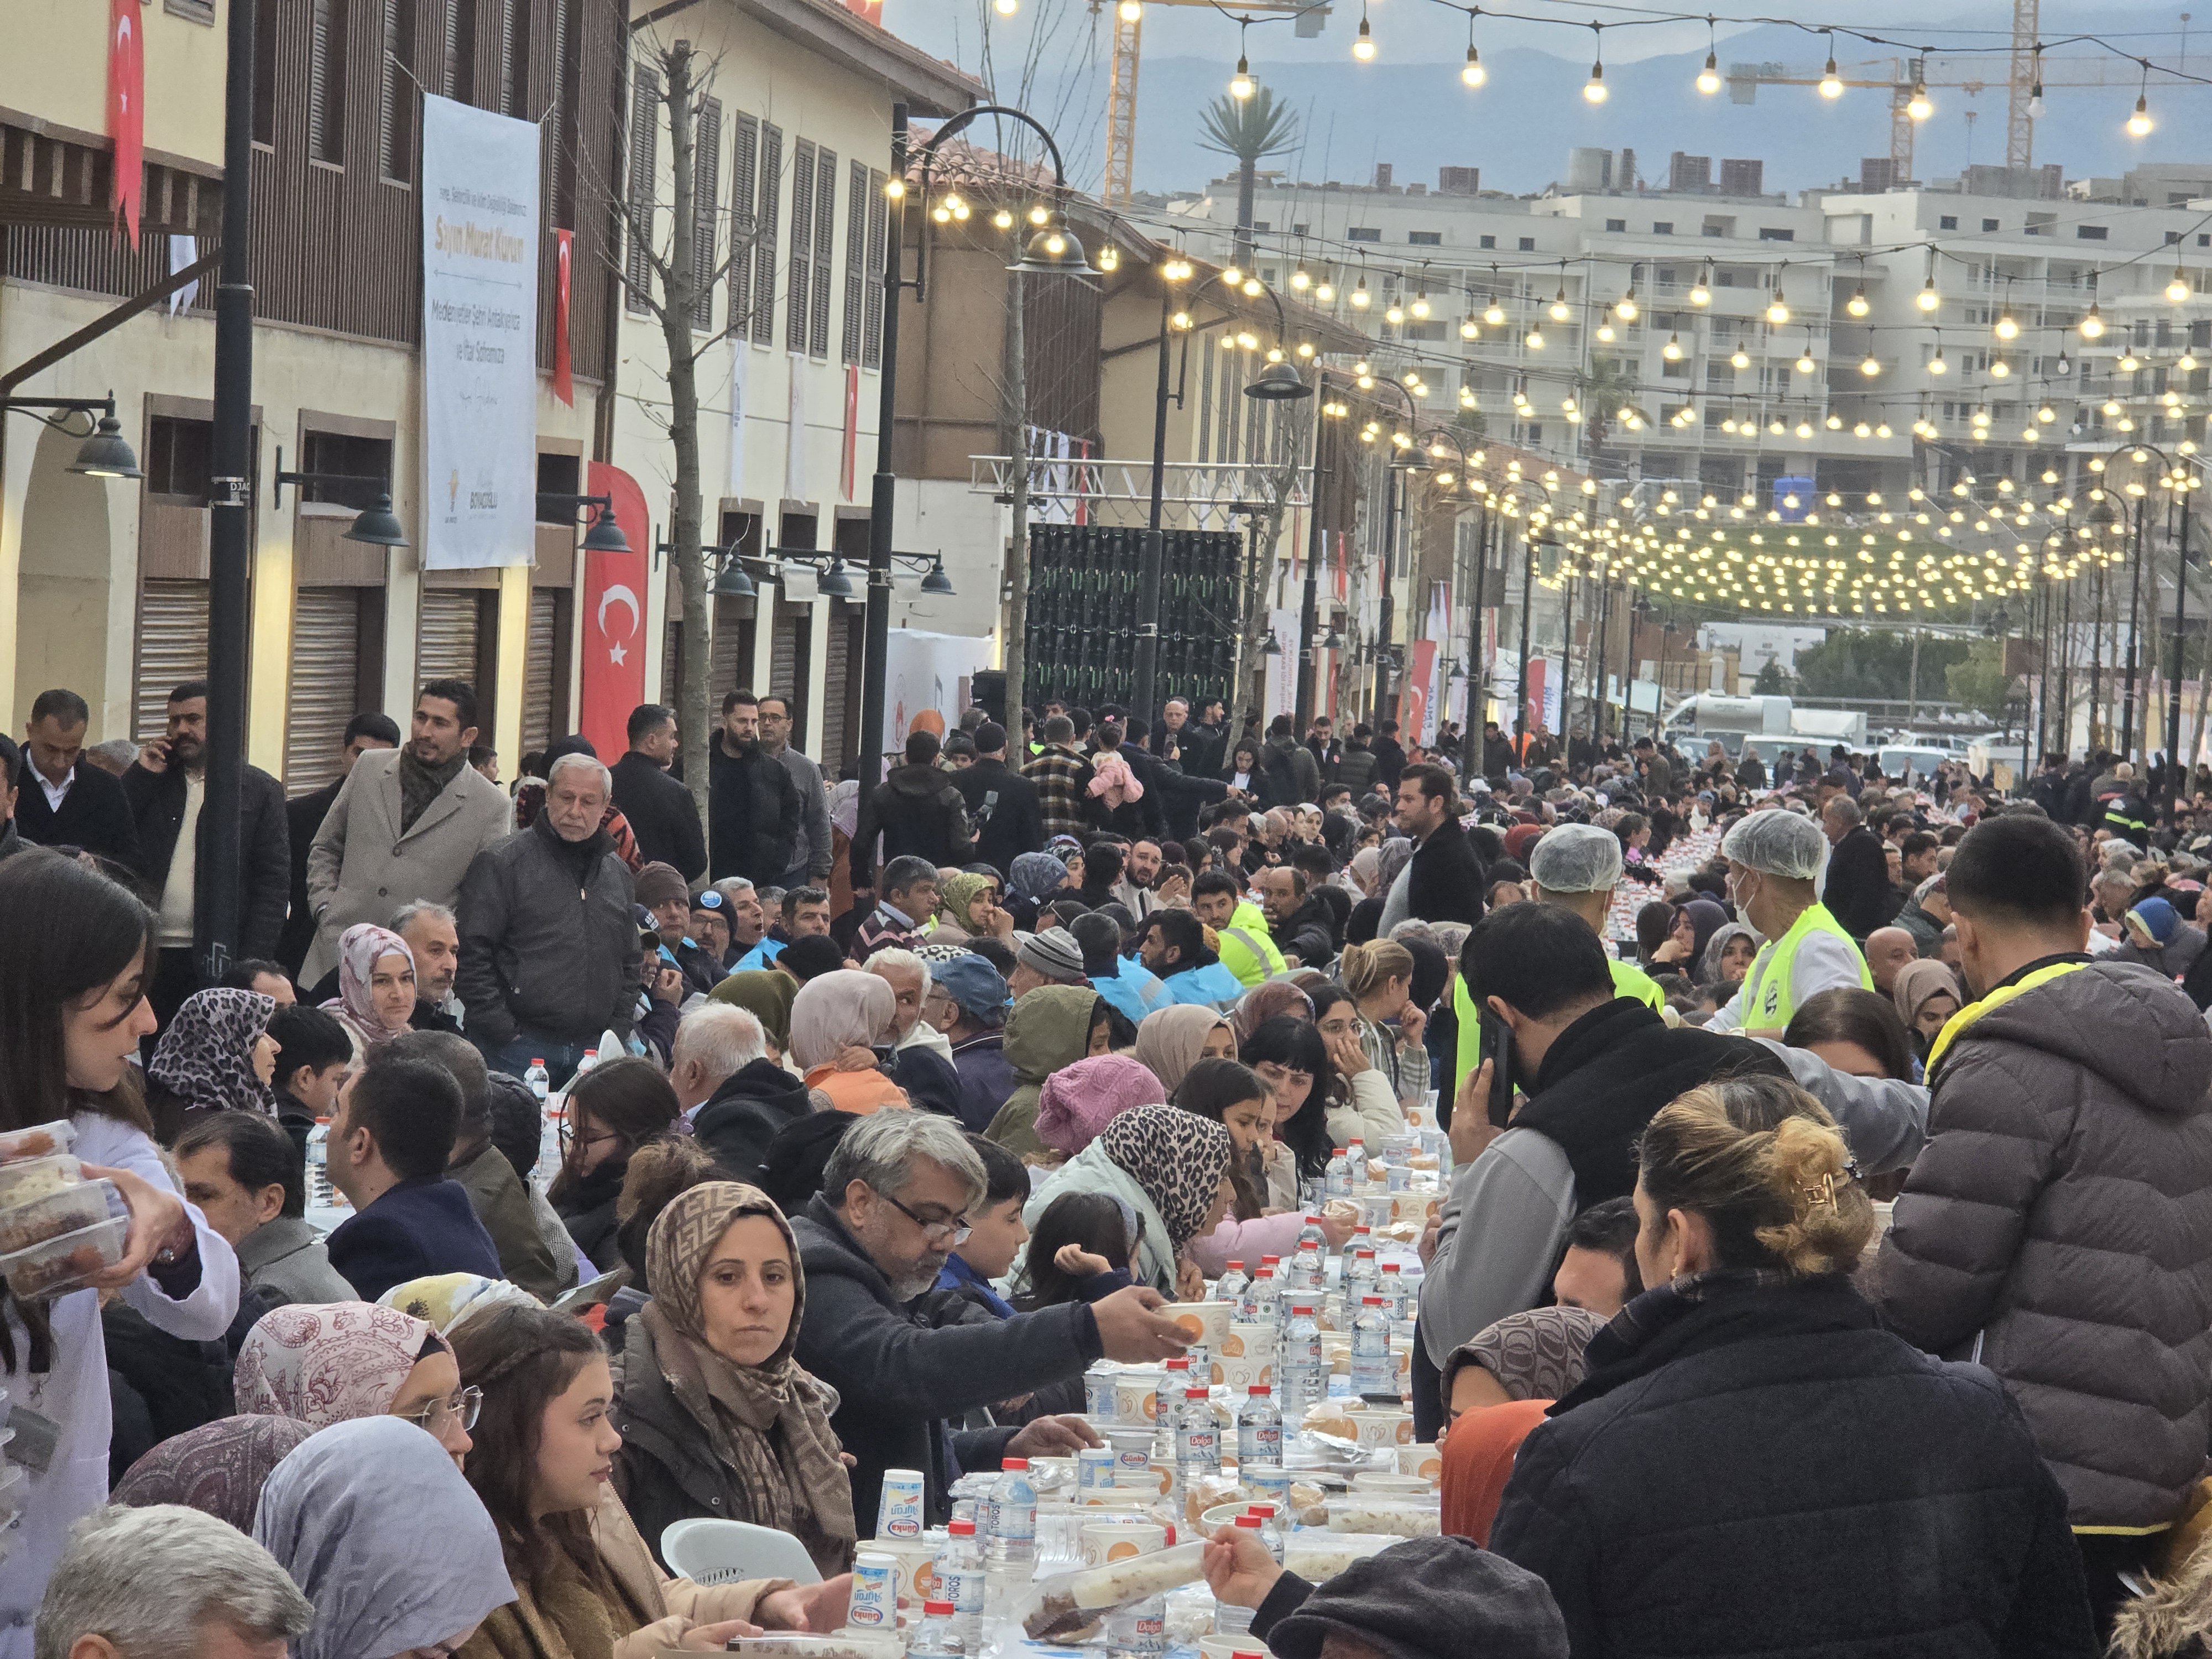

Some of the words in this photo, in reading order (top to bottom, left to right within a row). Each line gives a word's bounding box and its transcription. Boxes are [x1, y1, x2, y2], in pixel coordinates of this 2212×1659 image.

[1191, 1436, 1212, 1446] Dalga
[1258, 1431, 1277, 1441] Dalga
[1123, 1454, 1146, 1462] Günka
[990, 1504, 1000, 1530] TOROS
[891, 1525, 919, 1533] Günka
[948, 1576, 961, 1601] TOROS
[853, 1610, 880, 1622] Günka
[1138, 1621, 1161, 1634] Dalga
